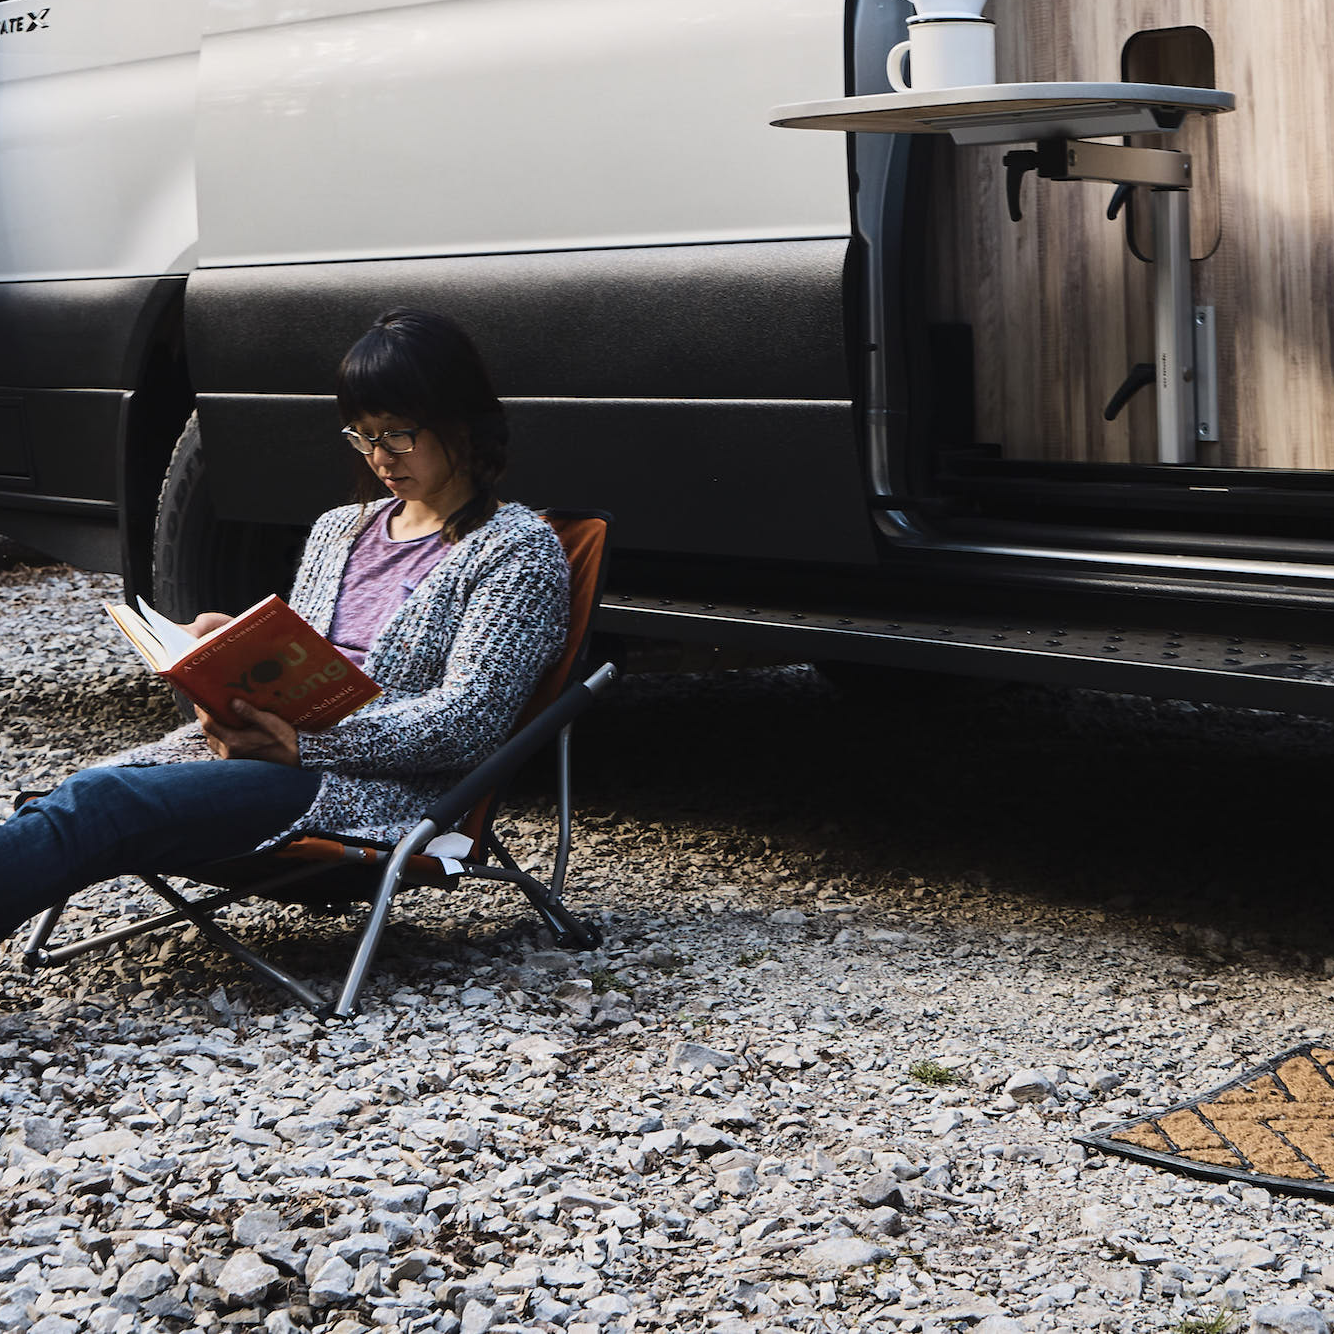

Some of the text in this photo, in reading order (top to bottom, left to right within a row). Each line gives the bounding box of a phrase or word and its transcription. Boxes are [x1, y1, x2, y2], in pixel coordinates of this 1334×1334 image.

[192, 649, 212, 666] Call
[212, 641, 227, 653] for
[227, 609, 278, 644] Connection
